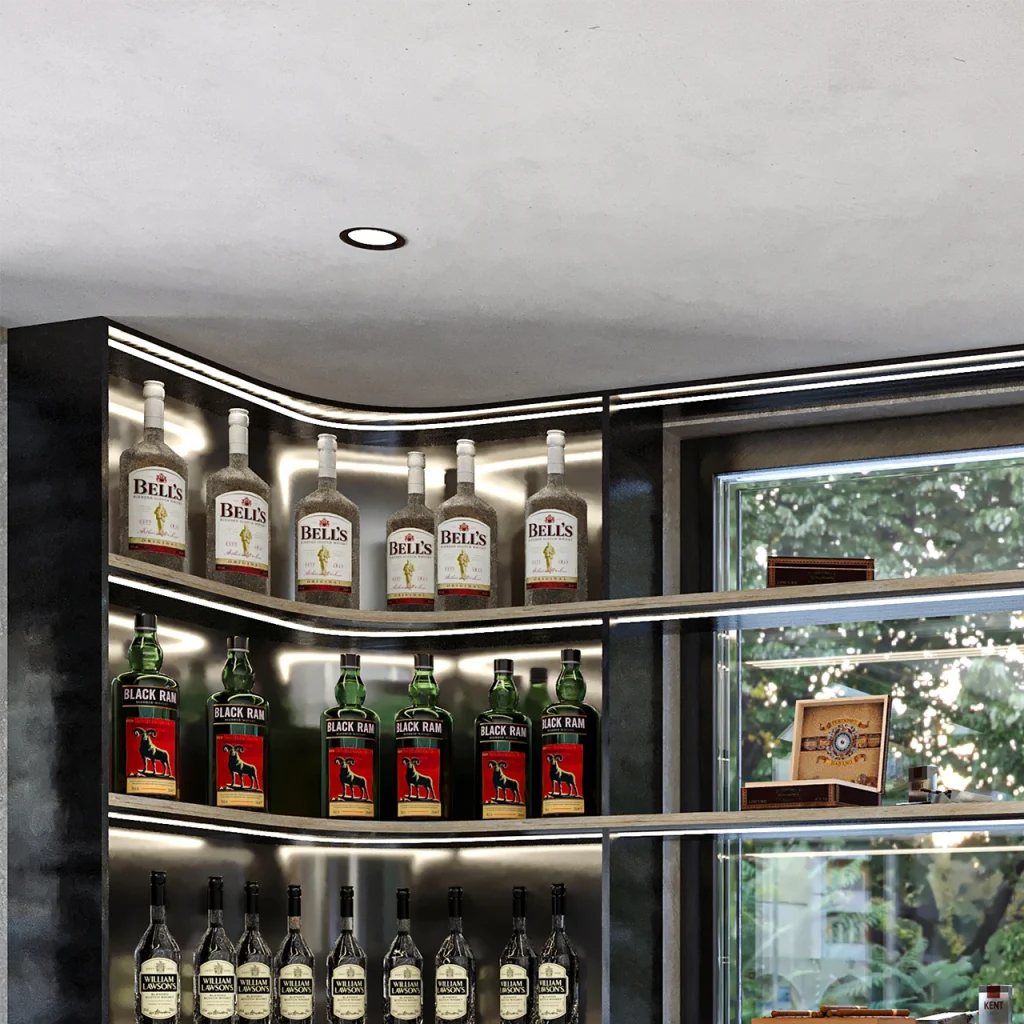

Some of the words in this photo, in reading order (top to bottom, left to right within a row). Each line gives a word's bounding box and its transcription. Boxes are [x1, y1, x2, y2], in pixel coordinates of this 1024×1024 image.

[133, 478, 183, 501] BELL'S
[220, 502, 267, 523] BELL'S
[301, 525, 348, 541] BELL'S
[528, 522, 574, 538] BELL'S
[440, 530, 487, 546] BELL'S
[389, 540, 432, 556] BELL'S
[124, 687, 156, 700] BLACK
[160, 691, 177, 704] RAM
[214, 707, 243, 718] BLACK
[247, 708, 265, 720] RAM
[327, 722, 354, 732] BLACK
[358, 722, 376, 734] RAM
[396, 722, 420, 733] BLACK
[422, 722, 442, 734] RAM
[542, 716, 562, 729] BLACK
[565, 718, 585, 729] RAM
[480, 725, 506, 736] BLACK
[510, 726, 526, 738] RAM
[142, 983, 176, 991] LAWSON'S
[201, 984, 234, 992] LAWSON'S
[984, 1001, 1003, 1010] KENT
